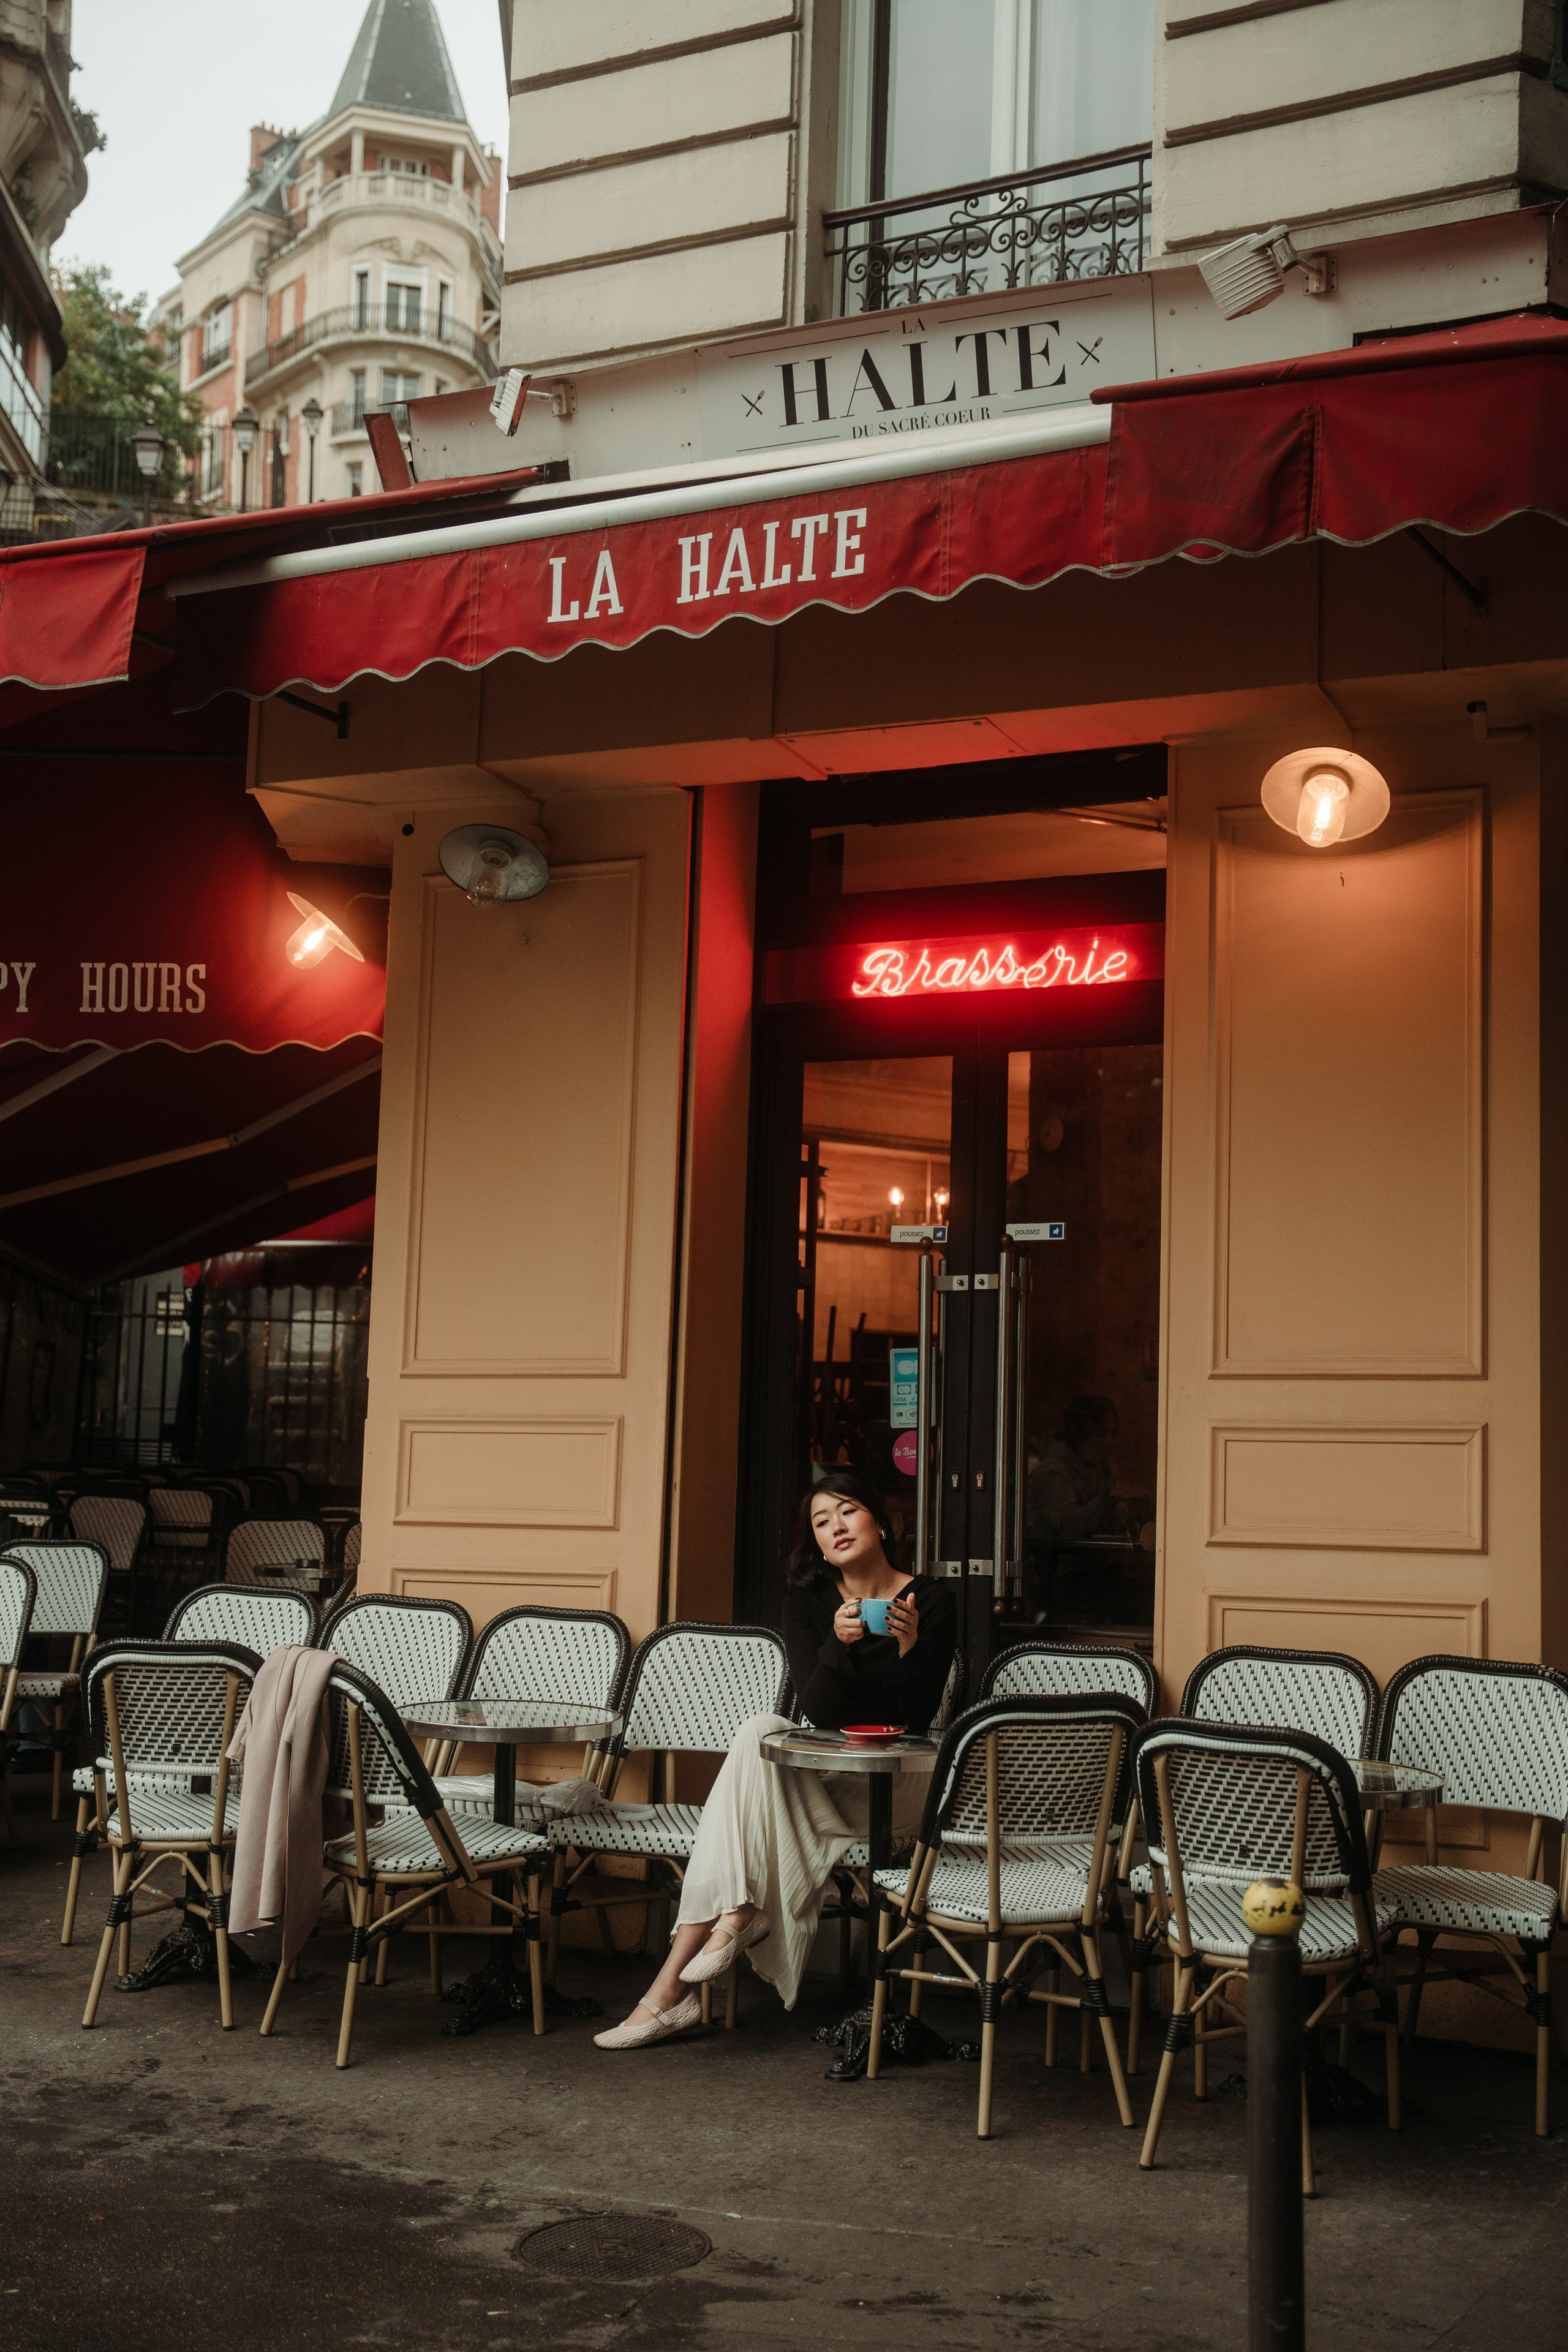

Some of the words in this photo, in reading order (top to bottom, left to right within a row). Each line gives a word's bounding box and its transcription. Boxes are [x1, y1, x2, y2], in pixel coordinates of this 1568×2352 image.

[901, 318, 926, 334] LA
[775, 320, 1066, 428] HALTE
[852, 423, 874, 439] DU
[879, 412, 930, 435] SACRÉ
[935, 407, 991, 427] COEUR
[548, 549, 624, 623] LA
[676, 507, 867, 605] HALTE
[80, 962, 206, 1014] HOURS
[851, 940, 1127, 997] Brasserie
[1015, 1229, 1041, 1237] poussez
[895, 1448, 902, 1457] le
